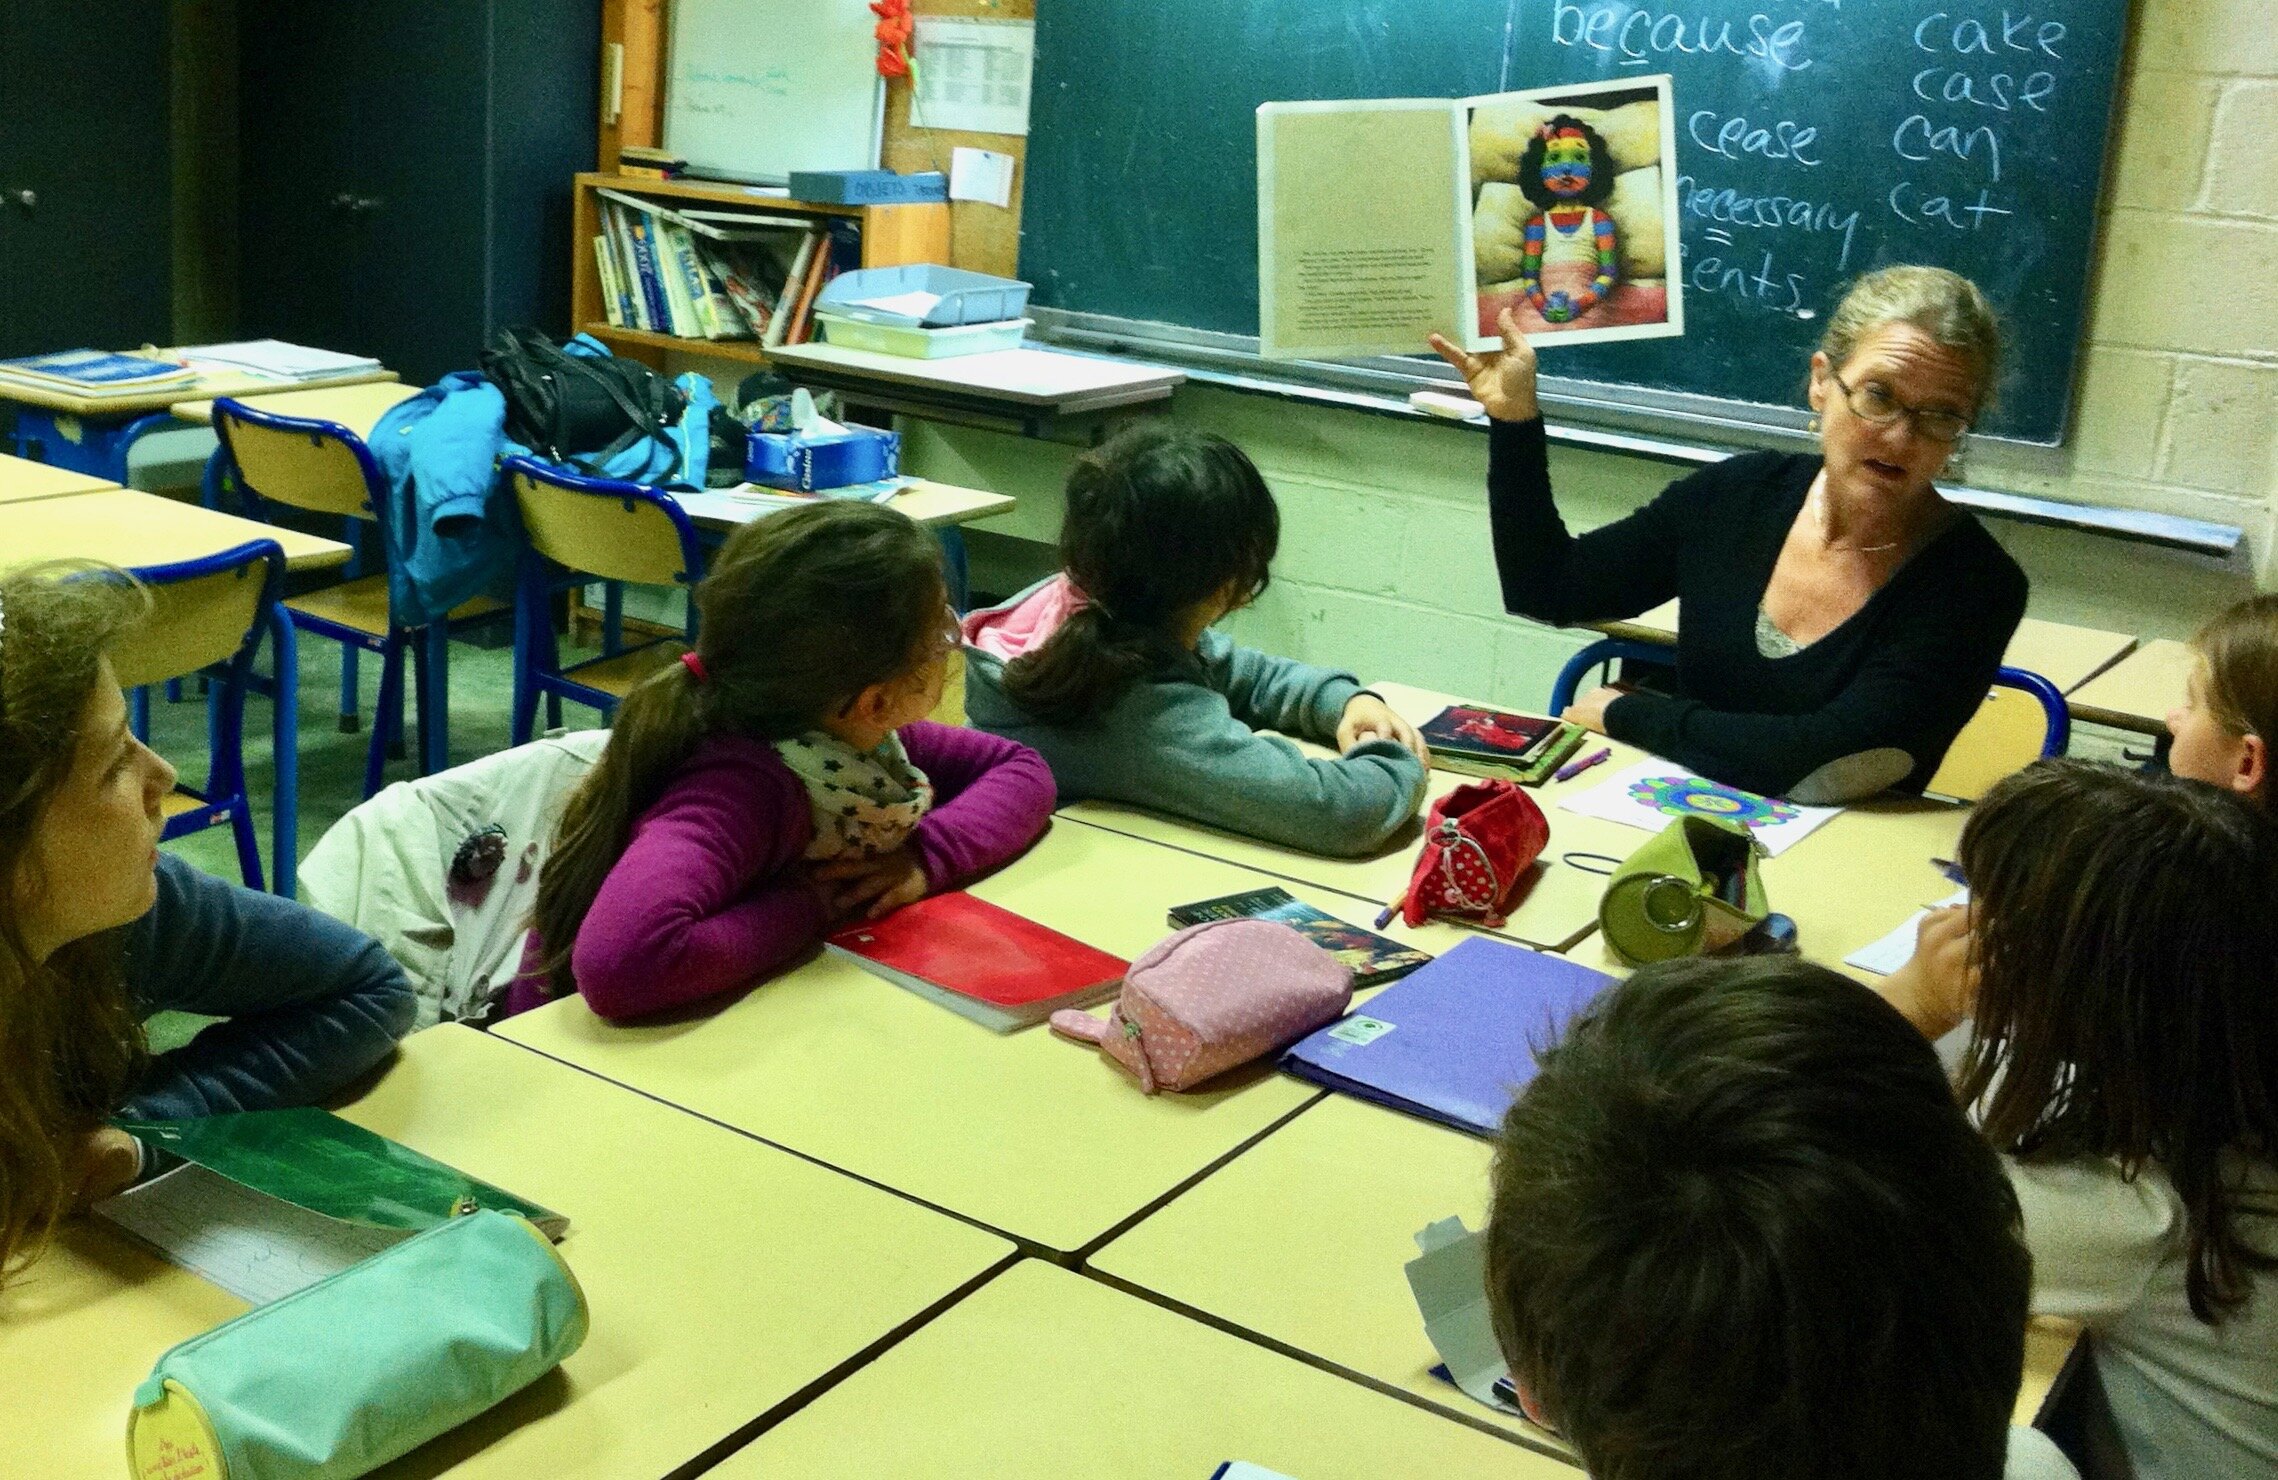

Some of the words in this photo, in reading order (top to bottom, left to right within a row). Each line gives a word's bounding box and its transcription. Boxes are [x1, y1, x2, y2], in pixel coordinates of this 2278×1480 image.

[1552, 0, 1813, 70] because
[1914, 9, 2067, 60] cake
[1913, 66, 2056, 112] case
[1681, 243, 1806, 313] ents
